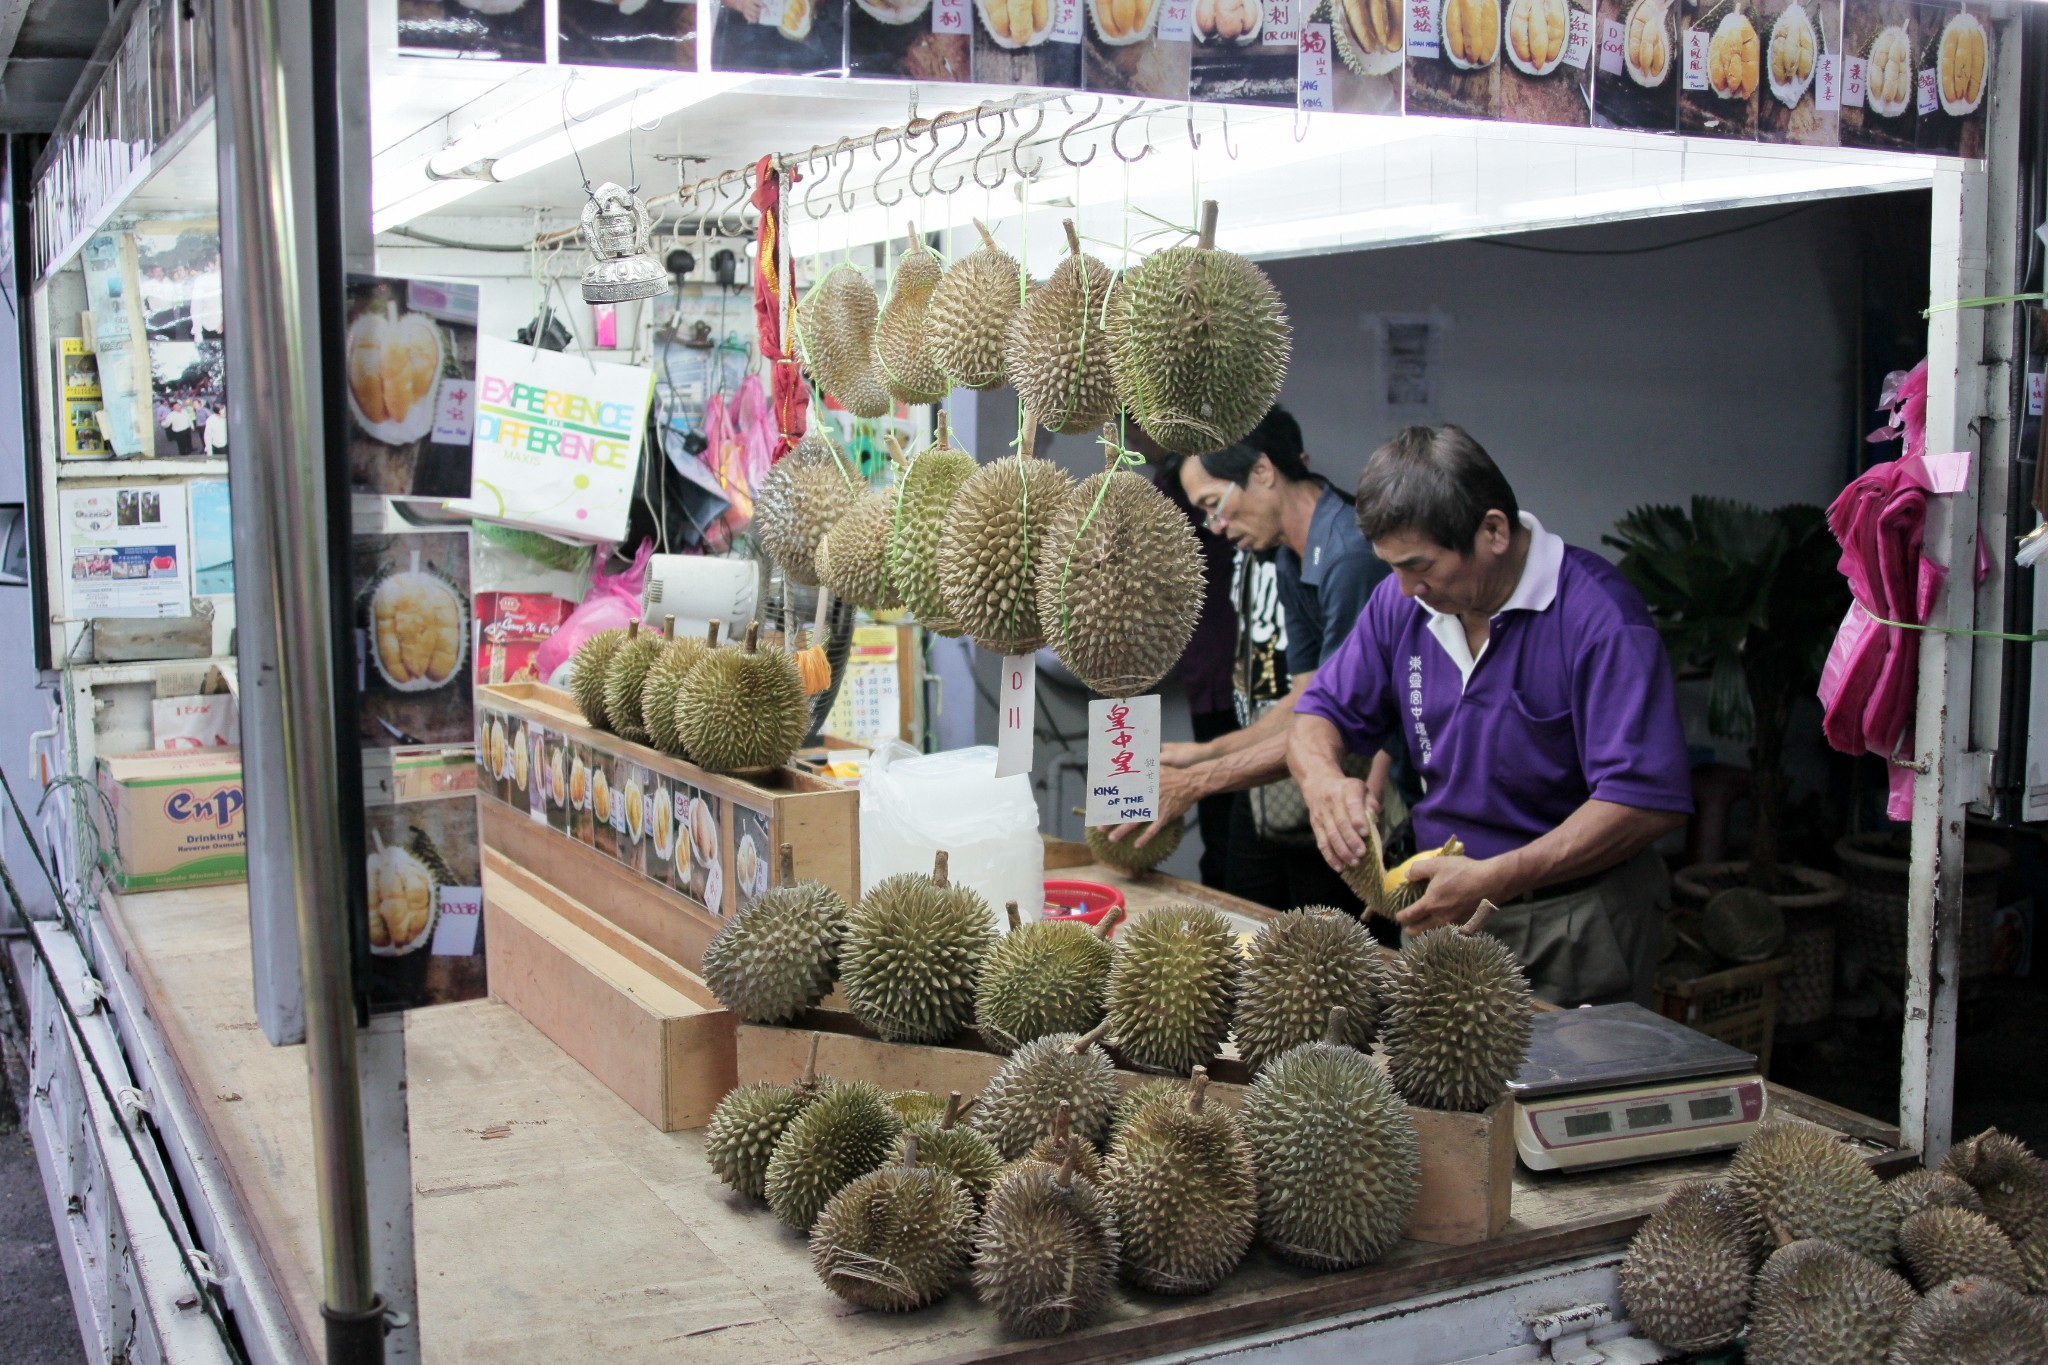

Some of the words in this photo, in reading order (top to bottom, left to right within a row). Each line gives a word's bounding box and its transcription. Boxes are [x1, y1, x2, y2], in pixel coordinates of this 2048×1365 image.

[1268, 0, 1289, 24] 刺
[1411, 0, 1432, 33] 蜈蚣
[1264, 31, 1278, 40] OR
[1280, 31, 1297, 40] CHI
[1609, 27, 1618, 39] D
[481, 376, 635, 432] EXPERIENCE
[547, 418, 564, 429] THE
[477, 414, 630, 470] DIFFERENCE
[503, 449, 543, 467] MAXIS
[1012, 671, 1023, 691] D
[1105, 704, 1141, 777] 皇中皇
[1094, 786, 1119, 797] KING
[1107, 798, 1120, 806] OF
[1123, 796, 1144, 805] THE
[1120, 808, 1151, 819] KING
[186, 832, 234, 843] Drinking
[178, 845, 210, 853] Reverse
